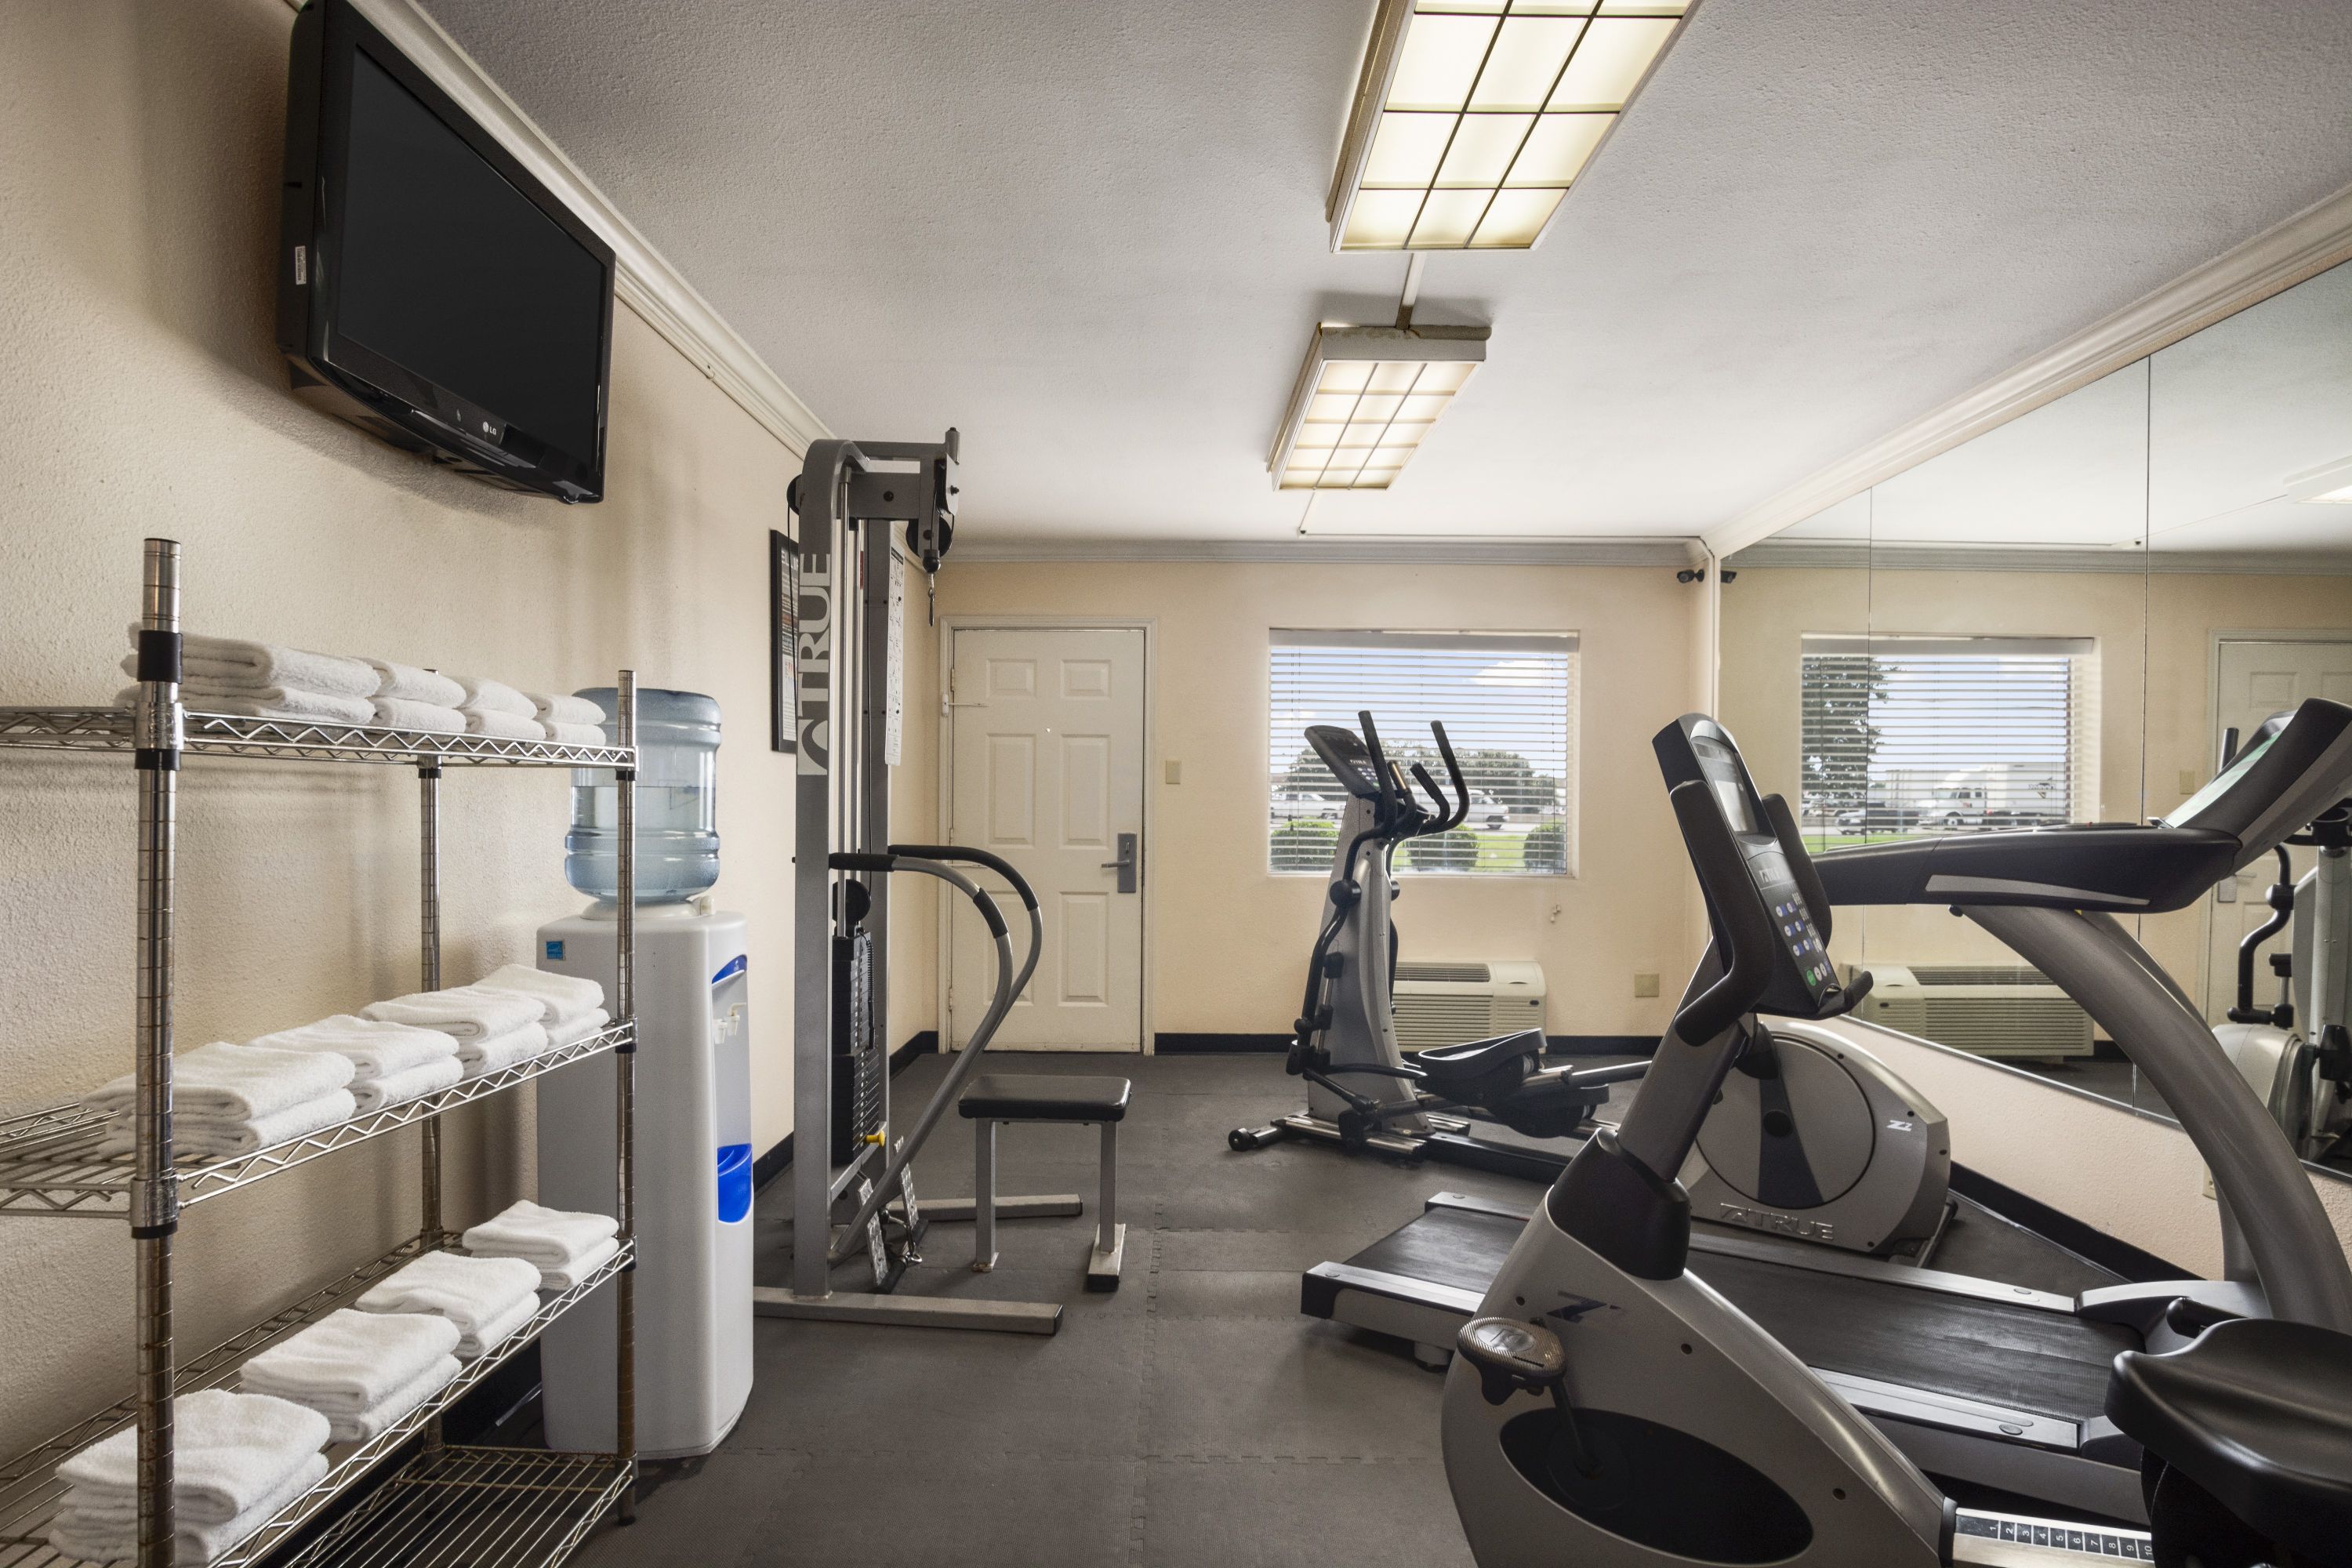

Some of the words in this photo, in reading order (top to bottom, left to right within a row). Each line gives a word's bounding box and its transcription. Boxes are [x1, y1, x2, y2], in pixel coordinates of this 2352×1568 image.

[489, 426, 497, 436] LG
[797, 553, 831, 717] TRUE
[1747, 1208, 1834, 1240] TRUE
[2144, 1545, 2153, 1556] 10
